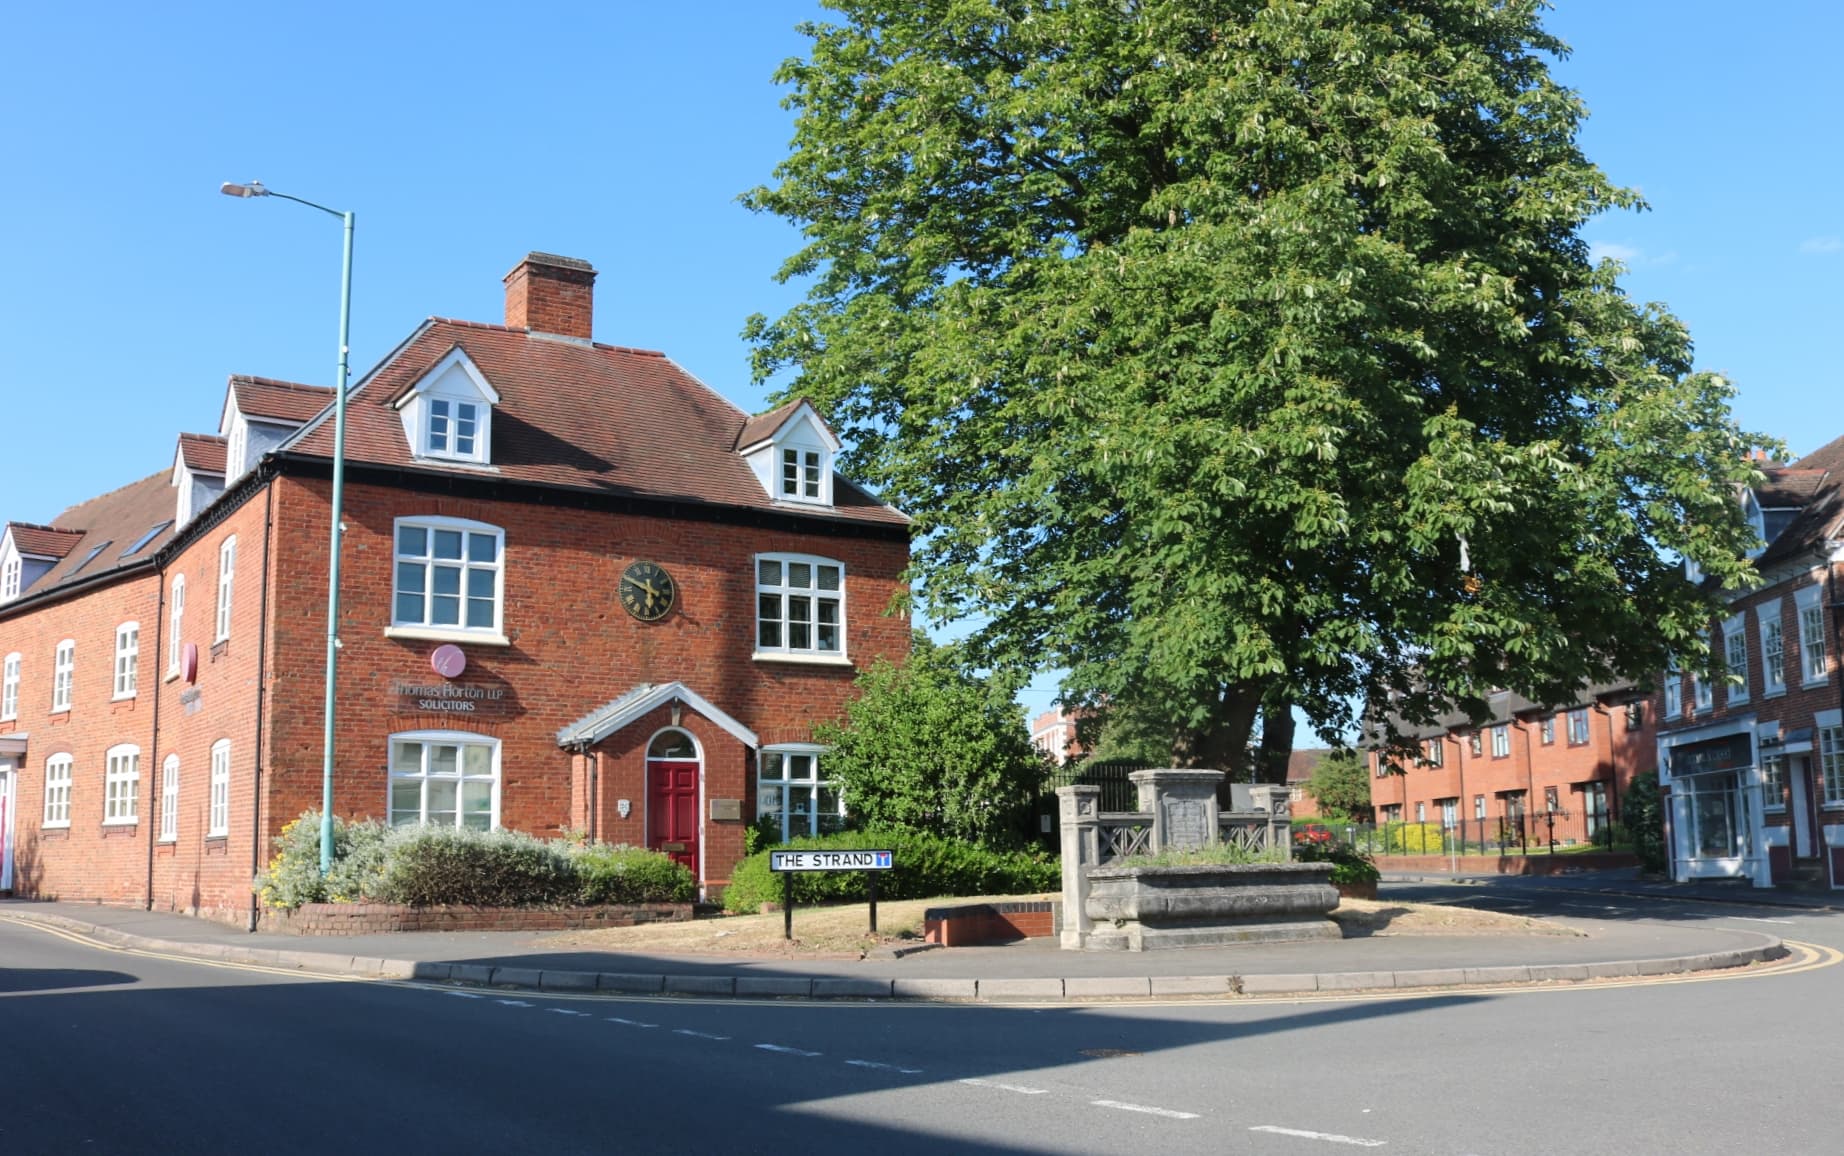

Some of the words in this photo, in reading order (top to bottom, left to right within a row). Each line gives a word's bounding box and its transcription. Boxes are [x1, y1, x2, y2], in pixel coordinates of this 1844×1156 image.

[443, 684, 484, 699] Horton
[487, 689, 504, 700] LLP
[419, 699, 475, 711] SOLICITORS
[776, 855, 803, 867] THE
[813, 853, 873, 867] STRAND
